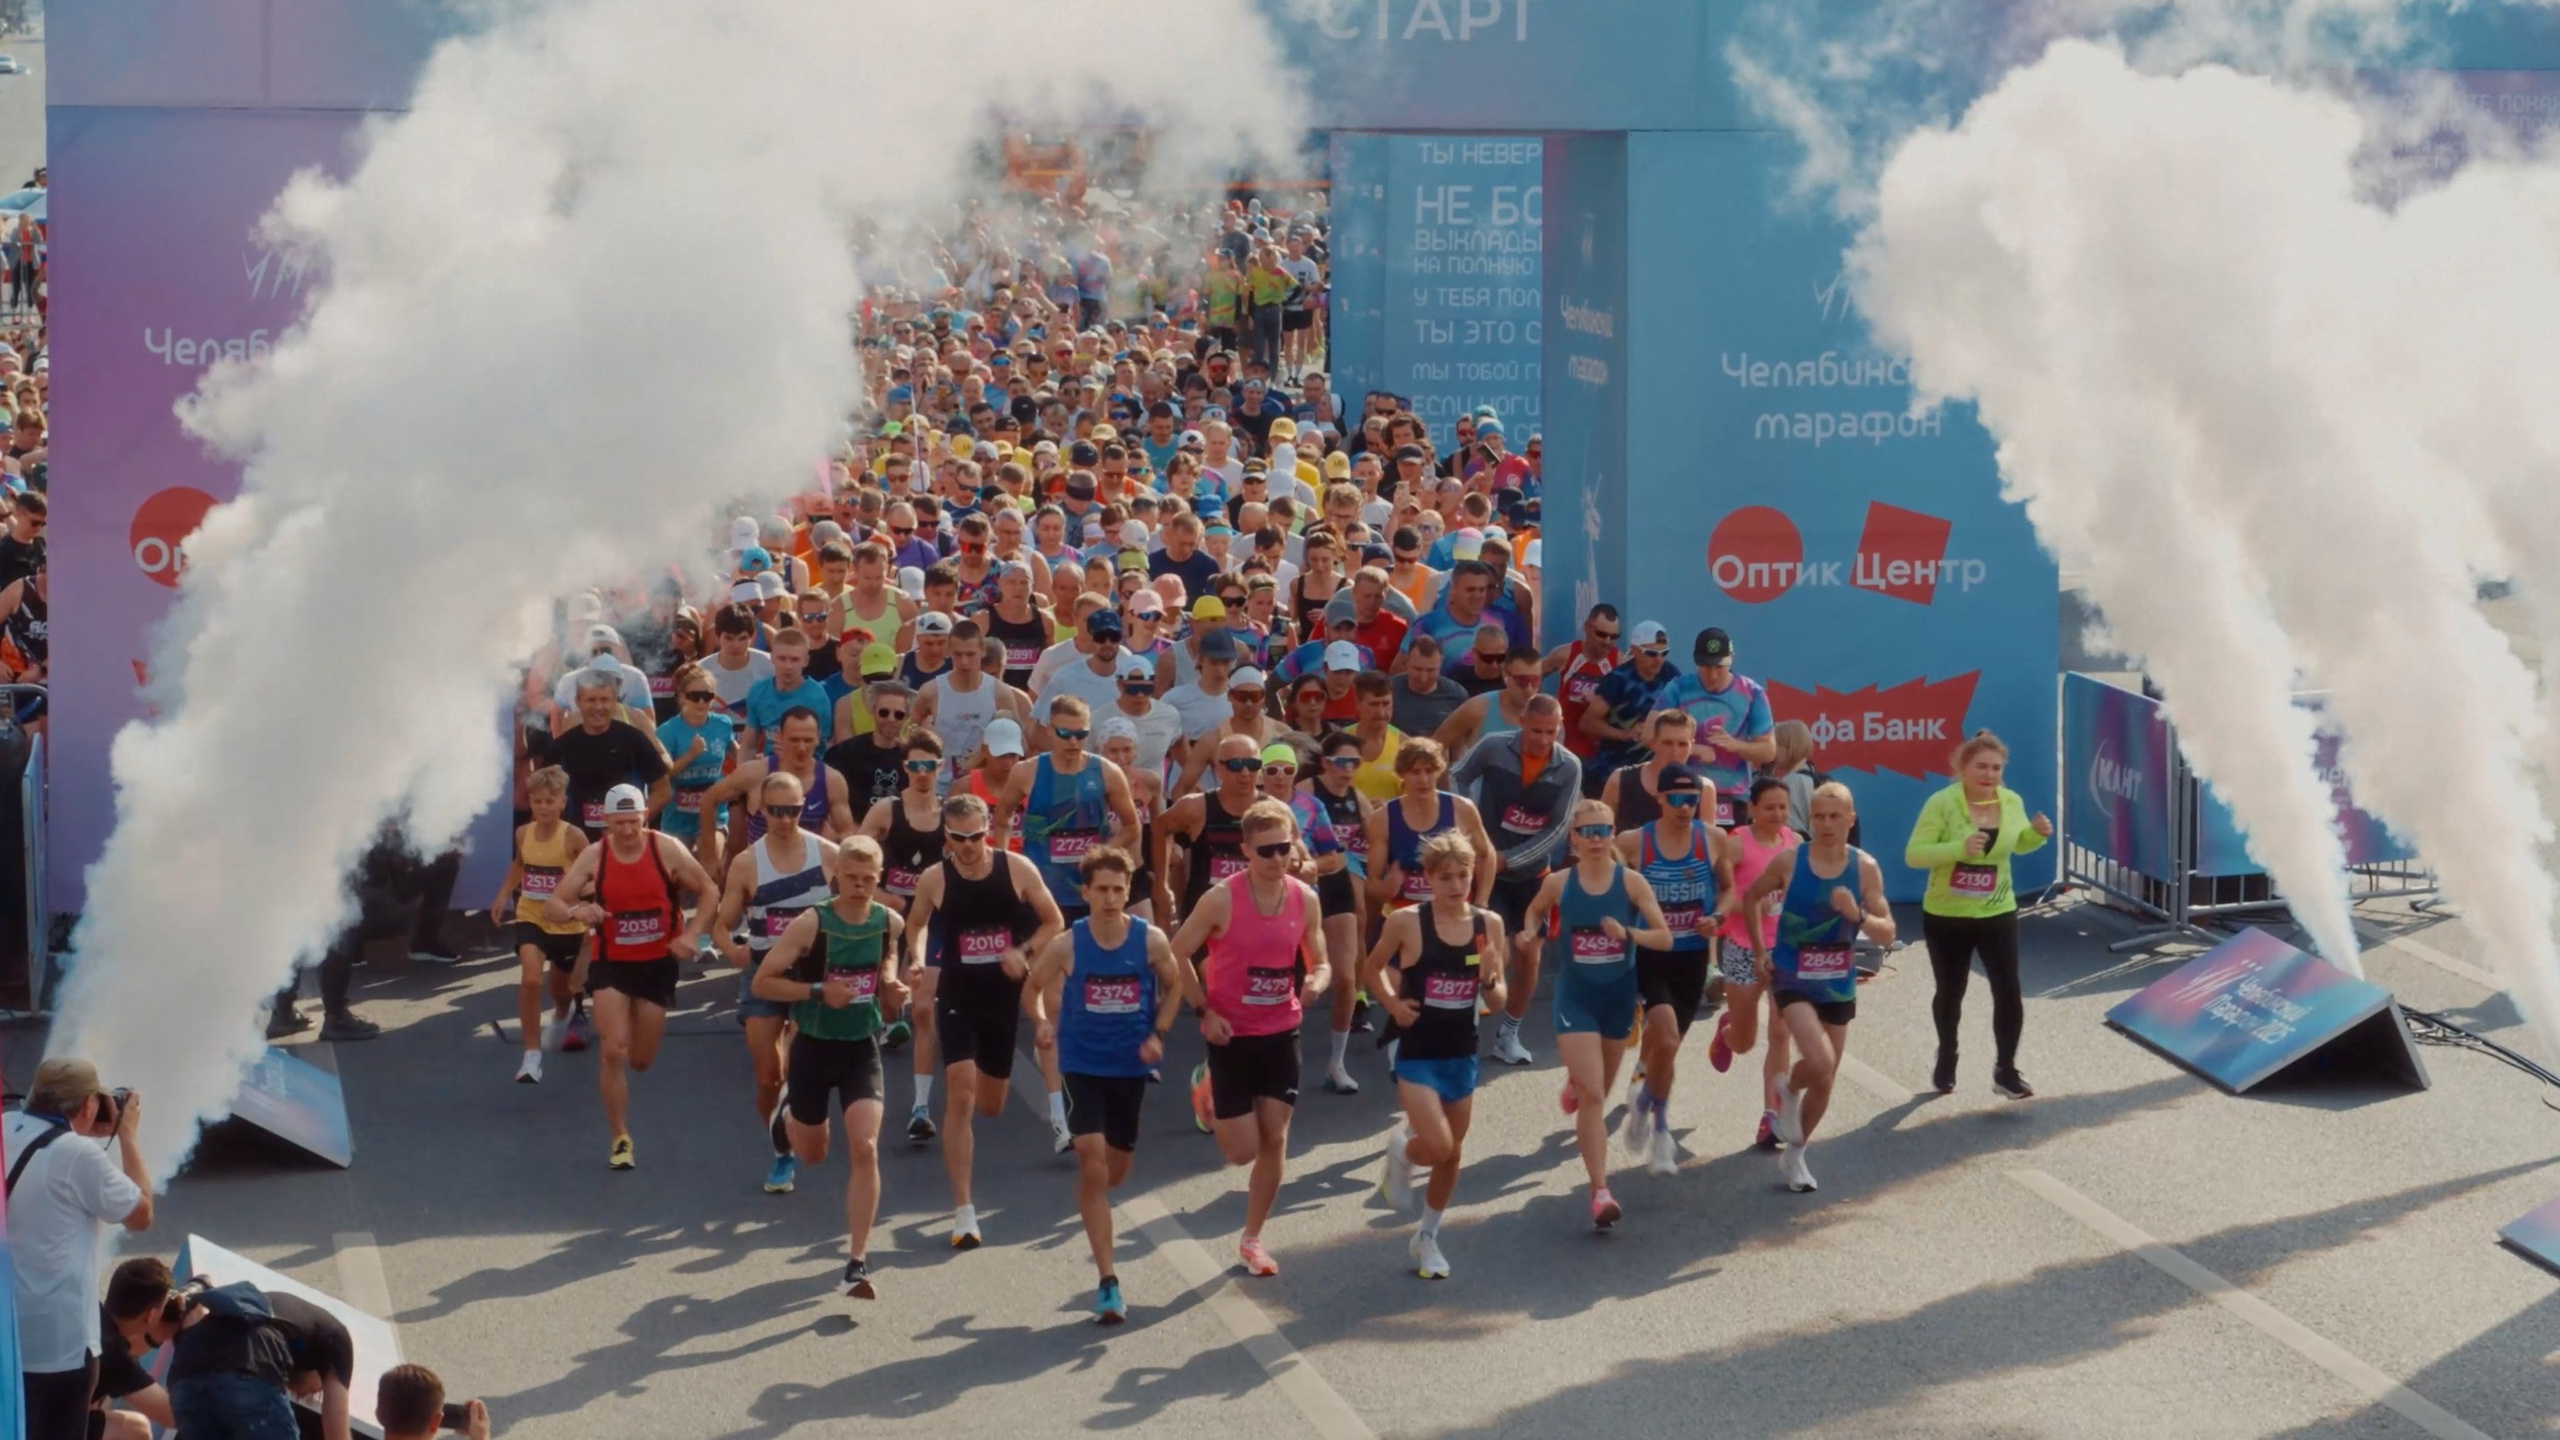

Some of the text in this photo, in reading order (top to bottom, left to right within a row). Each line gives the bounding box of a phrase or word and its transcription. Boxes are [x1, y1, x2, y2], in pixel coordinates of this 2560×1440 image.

[1419, 142, 1542, 165] ТЫ НЕВЕР
[1416, 185, 1473, 225] НЕ
[1414, 256, 1534, 276] НА ПОЛНУЮ
[1413, 287, 1540, 307] У ТЕБЯ ПОЛ
[1414, 319, 1454, 344] ТЫ
[1464, 319, 1515, 345] ЭТО
[1456, 360, 1519, 381] ТОБОЙ
[1754, 410, 1941, 448] марафон
[1712, 552, 1987, 592] Оптик Центр
[1863, 711, 1946, 742] Банк
[524, 873, 556, 889] 2513
[1956, 871, 1992, 886] 2130
[619, 919, 660, 934] 2038
[966, 935, 1006, 952] 2016
[1576, 936, 1621, 951] 2494
[1803, 952, 1845, 967] 2845
[1090, 985, 1136, 1000] 2374
[1251, 977, 1291, 992] 2479
